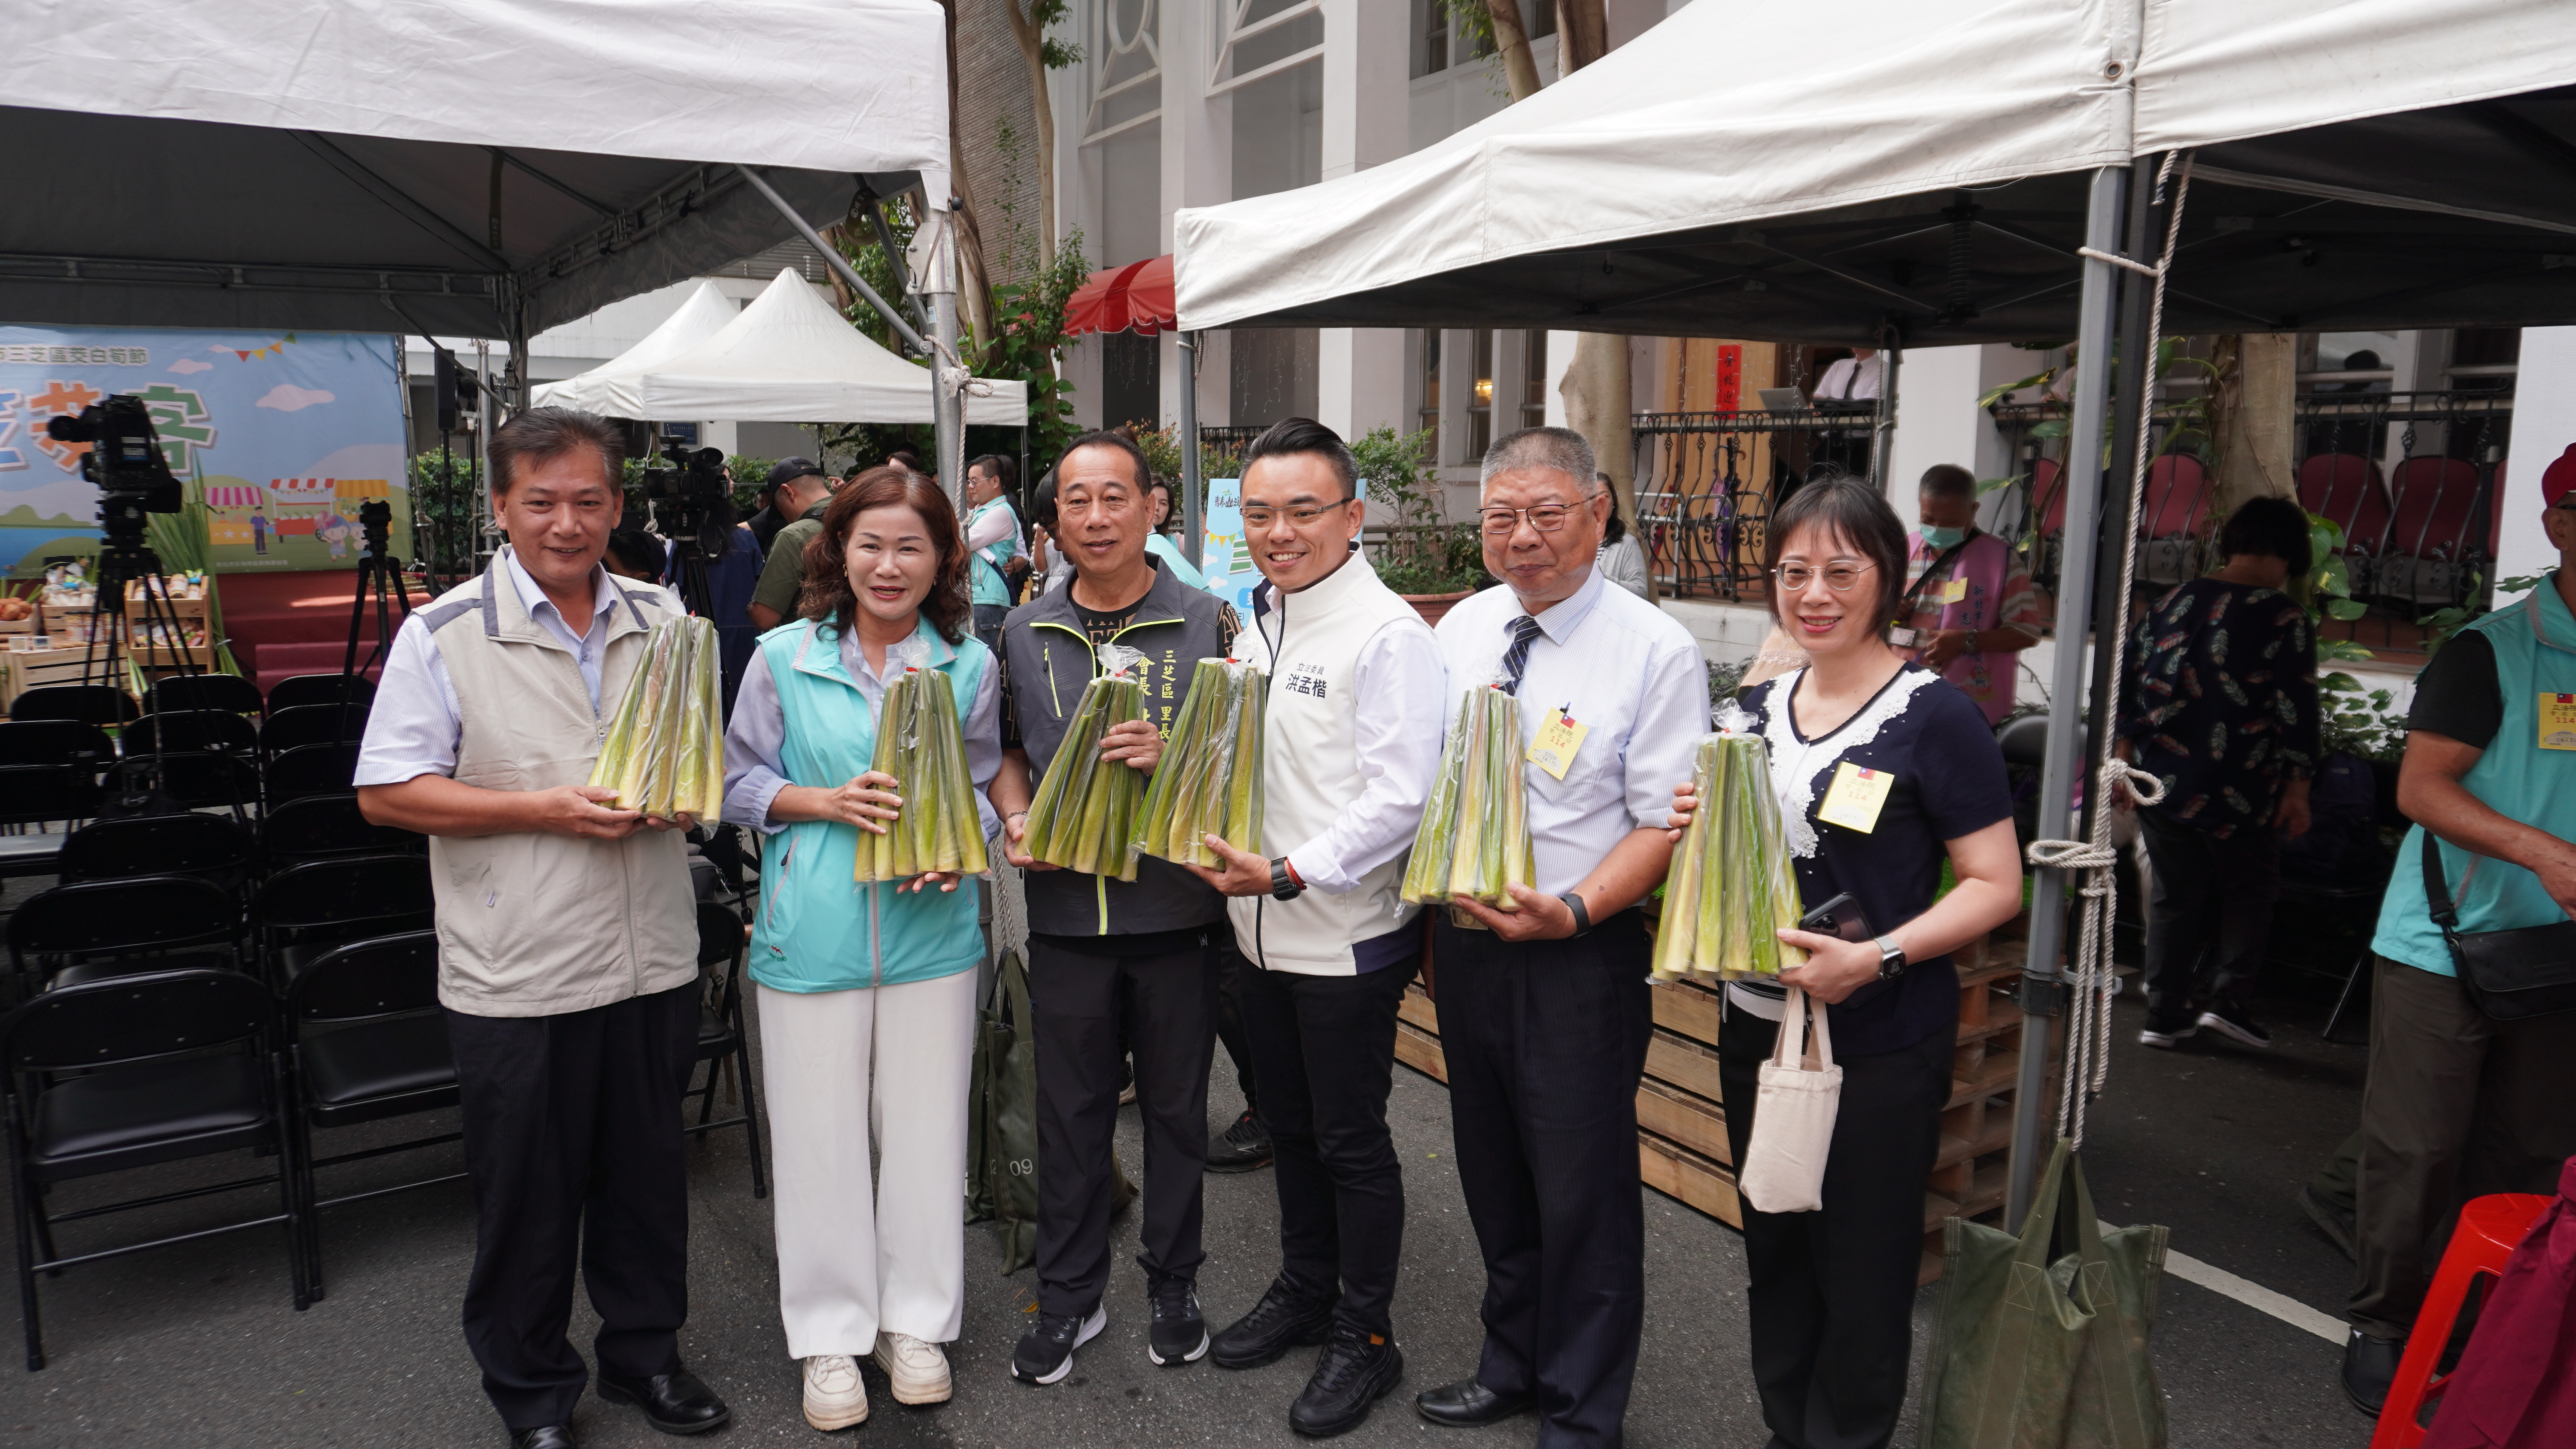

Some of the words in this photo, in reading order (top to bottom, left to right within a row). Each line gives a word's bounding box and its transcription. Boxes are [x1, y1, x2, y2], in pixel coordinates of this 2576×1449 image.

[1297, 663, 1324, 676] 立法委員
[1285, 673, 1327, 699] 洪孟楷
[1553, 723, 1574, 739] 立法院
[1550, 736, 1566, 748] 114
[1849, 778, 1876, 790] 立法院
[1848, 791, 1867, 801] 114
[1010, 1158, 1033, 1176] 09
